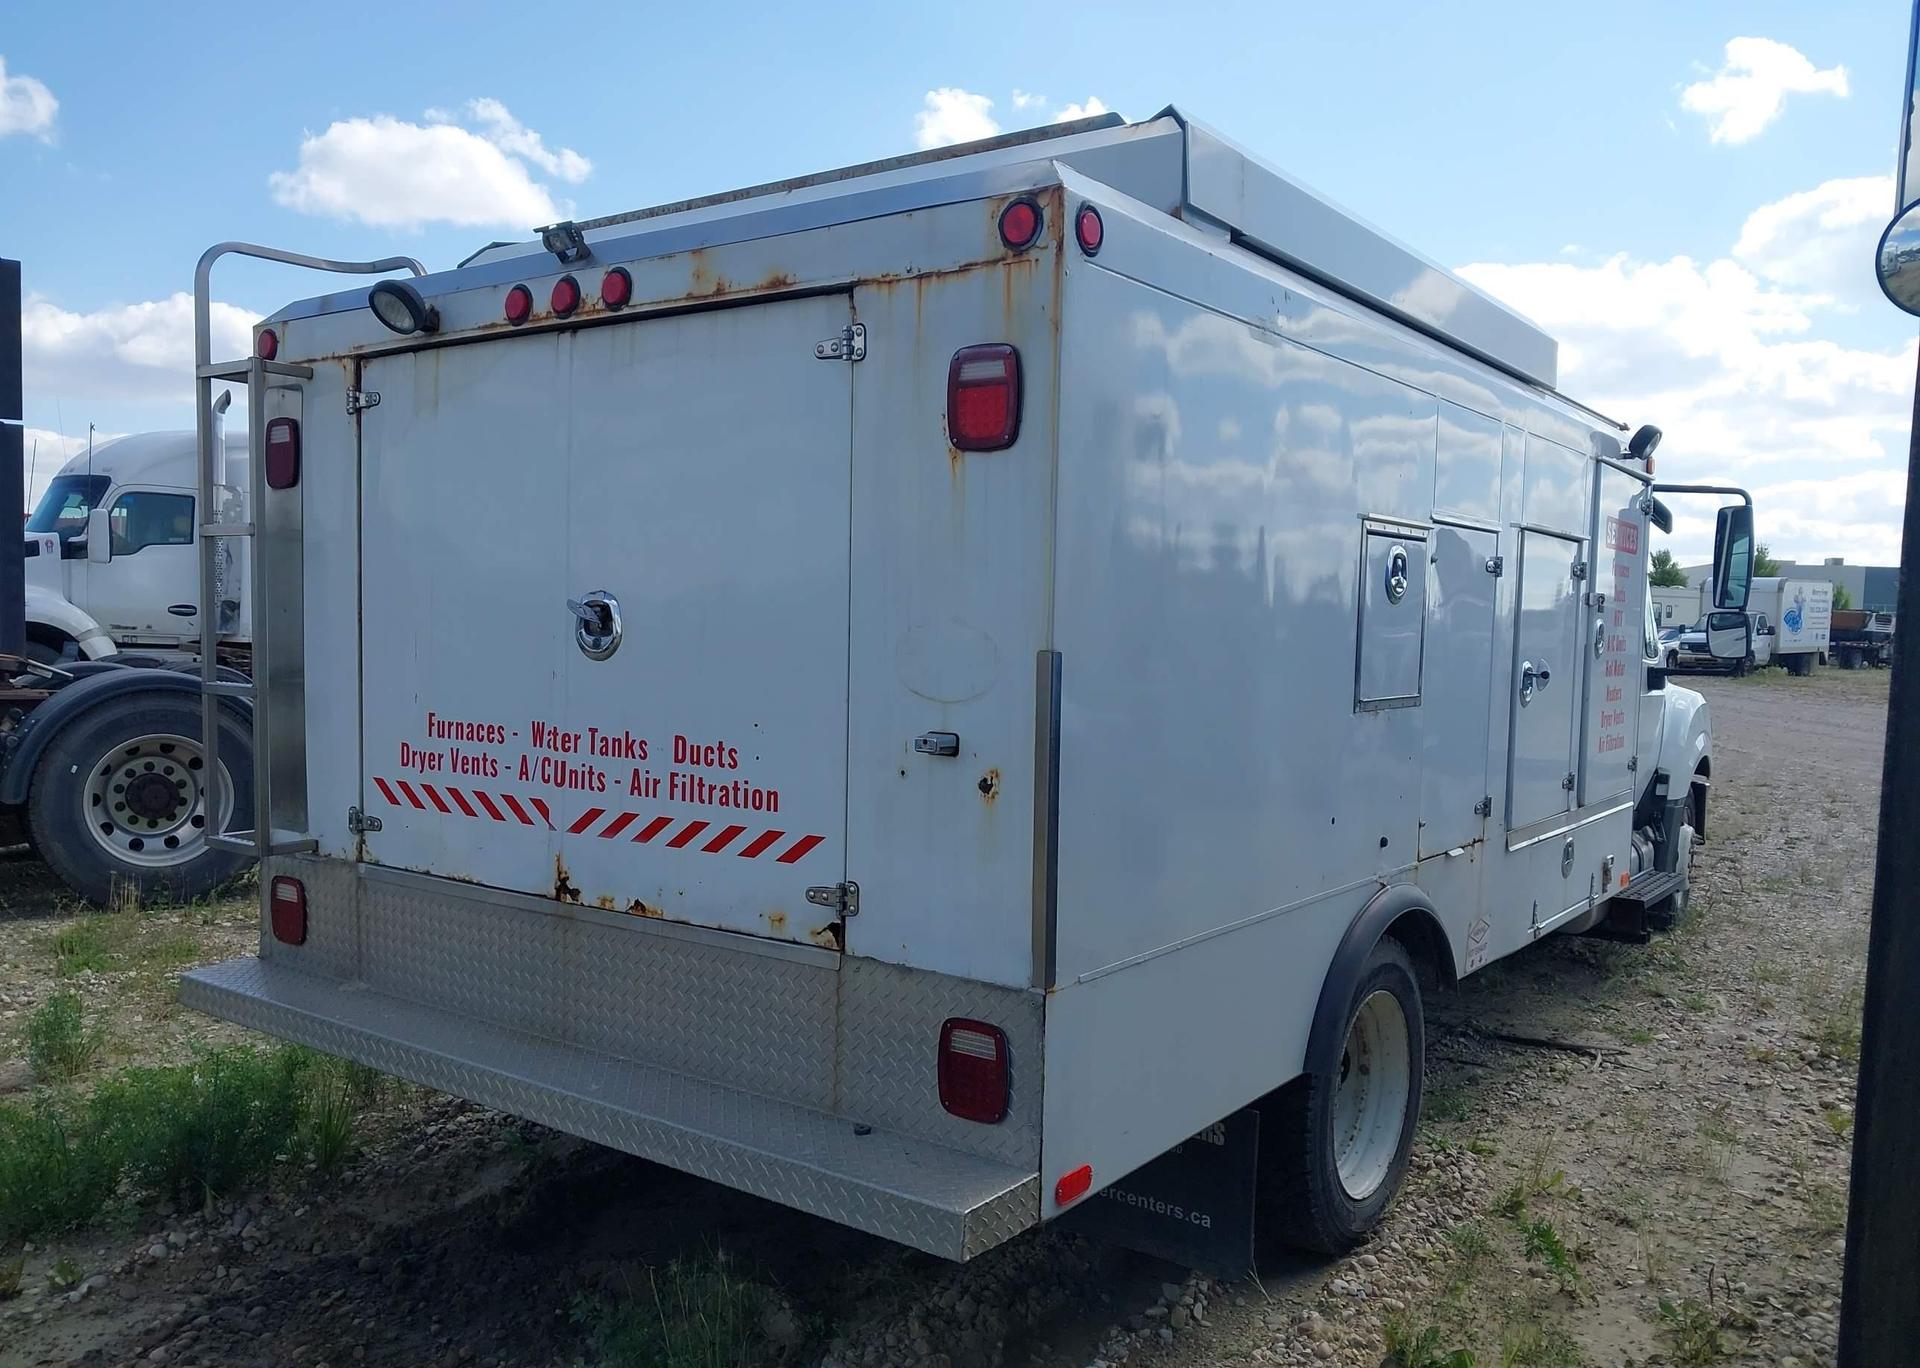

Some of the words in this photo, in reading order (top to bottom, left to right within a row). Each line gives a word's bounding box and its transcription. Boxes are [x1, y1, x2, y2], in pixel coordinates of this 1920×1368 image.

[428, 712, 505, 745] Furnaces
[588, 727, 649, 761] Tanks
[673, 734, 739, 770] Ducts
[400, 742, 444, 774] Dryer
[450, 747, 498, 778] Vents
[629, 768, 661, 799] Air
[668, 772, 779, 813] Filtration
